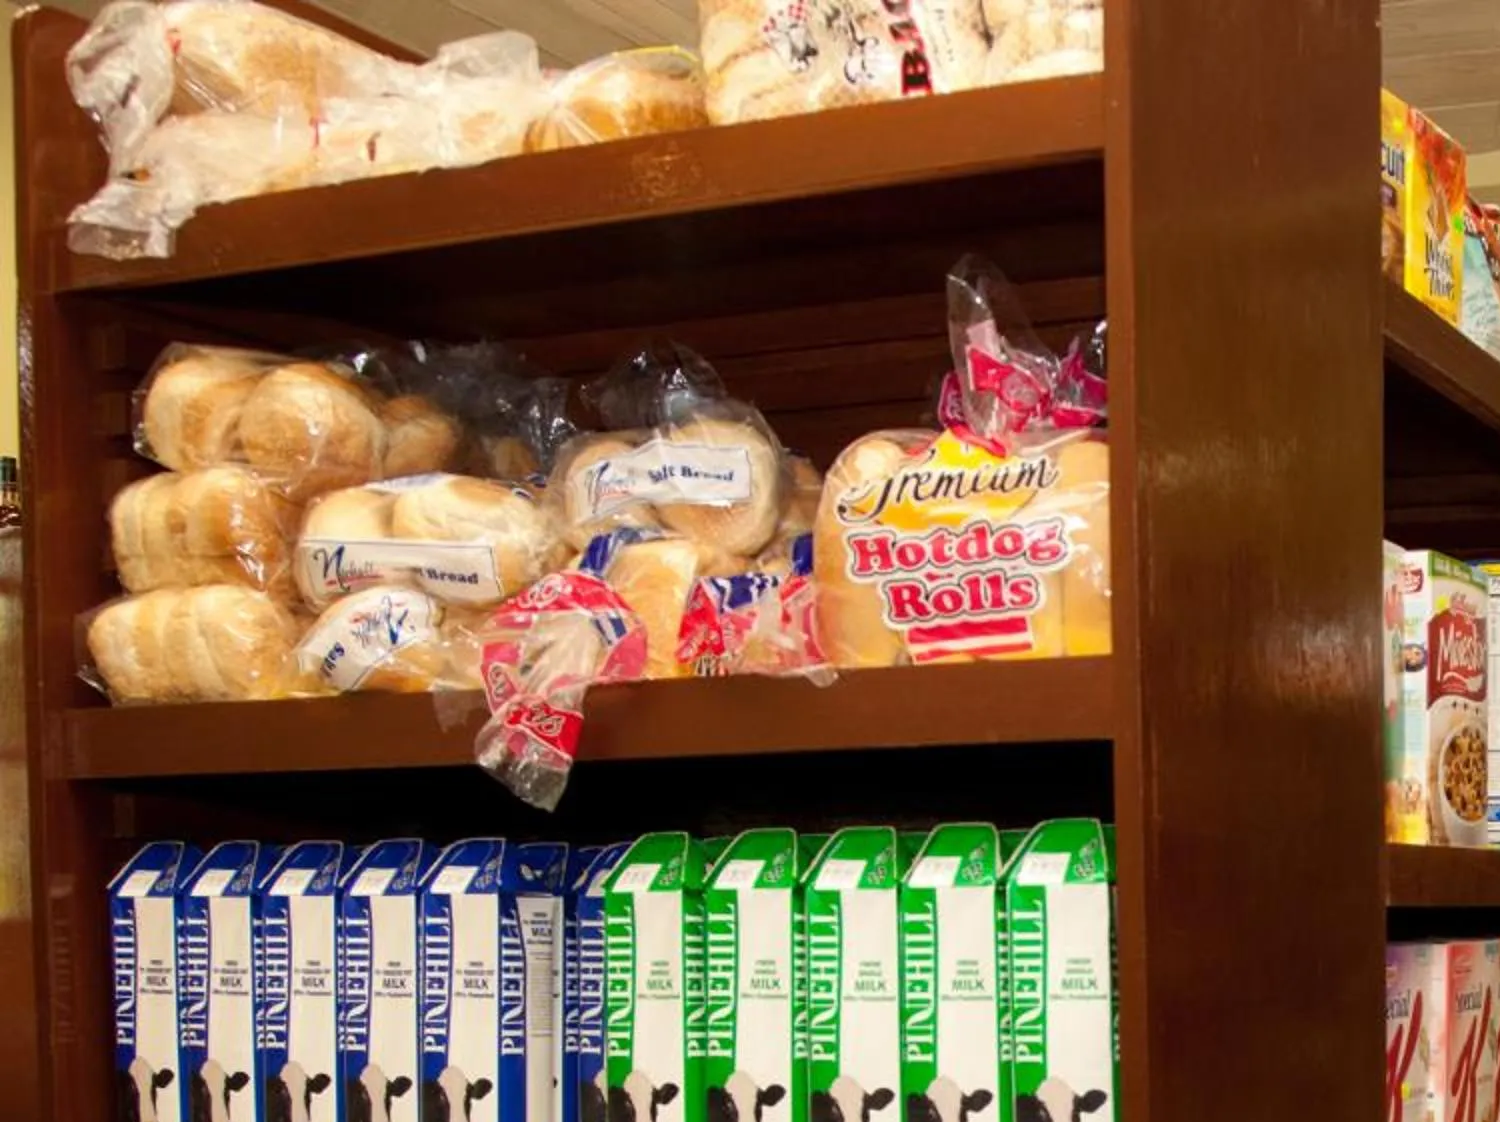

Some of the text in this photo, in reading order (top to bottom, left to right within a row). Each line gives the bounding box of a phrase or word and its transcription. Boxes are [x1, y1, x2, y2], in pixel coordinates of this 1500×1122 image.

[680, 465, 734, 482] Bread
[838, 448, 1058, 522] Premium
[426, 568, 479, 584] Bread
[850, 521, 1065, 574] Hotdog
[887, 570, 1036, 622] Rolls
[113, 909, 135, 1045] PINEHILL
[187, 909, 208, 1047] PINEHILL
[265, 909, 287, 1049] PINEHILL
[346, 909, 369, 1051] PINEHILL
[382, 978, 406, 989] MILK
[424, 907, 449, 1053] PINEHILL
[463, 978, 488, 990] MILK
[501, 908, 525, 1055] PINEHILL
[580, 909, 604, 1054] PINEHILL
[607, 905, 632, 1057] PINEHILL
[647, 979, 673, 989] MILK
[708, 903, 734, 1057] PINEHILL
[750, 979, 781, 989] MILK
[810, 904, 838, 1061] PINEHILL
[855, 980, 886, 991] MILK
[905, 901, 934, 1062] PINEHILL
[952, 979, 984, 991] MILK
[1013, 900, 1043, 1063] PINEHILL
[1061, 978, 1098, 990] MILK
